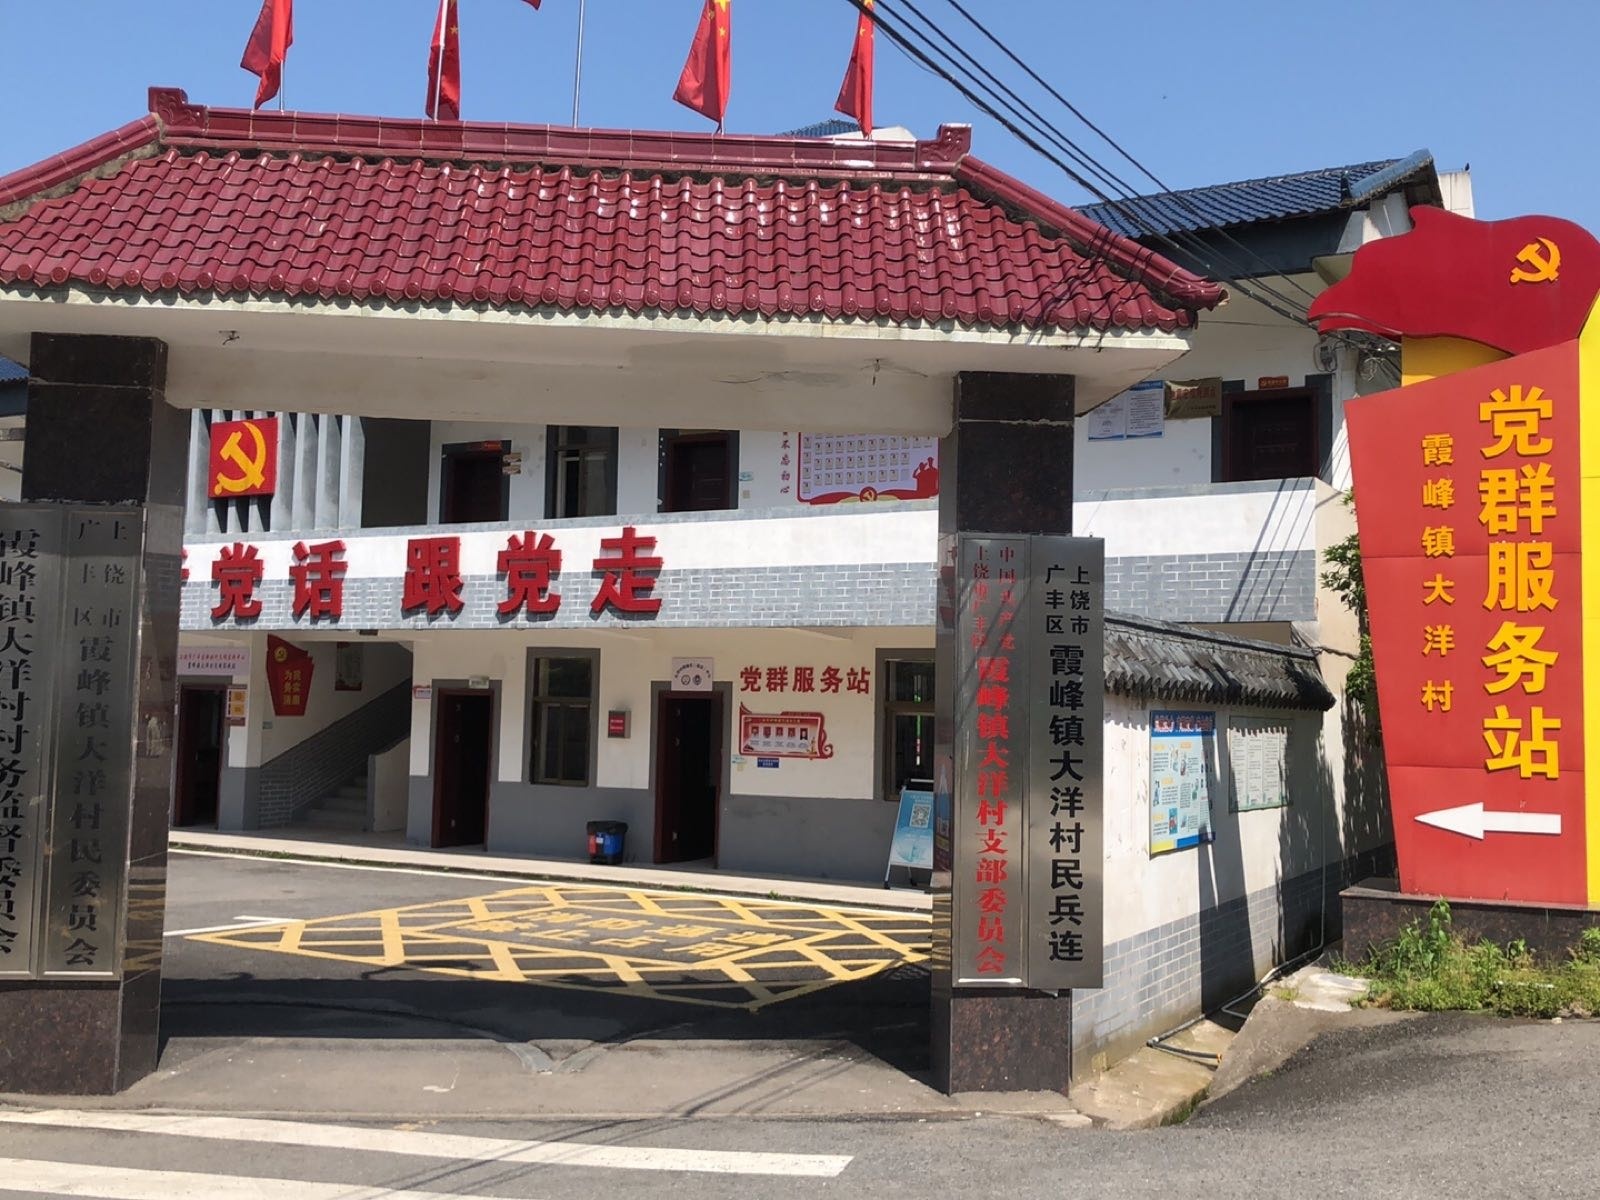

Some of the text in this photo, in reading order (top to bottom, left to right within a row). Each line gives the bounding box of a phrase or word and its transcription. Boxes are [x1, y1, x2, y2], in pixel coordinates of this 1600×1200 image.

[102, 520, 127, 628] 上饶市
[180, 526, 664, 619] 党话跟党走
[1045, 564, 1065, 635] 广丰区
[1070, 566, 1091, 636] 上饶市
[1421, 433, 1456, 714] 霞峰镇大洋村
[1479, 384, 1561, 779] 党群服务站
[739, 665, 872, 695] 党群服务站
[64, 635, 113, 965] 霞峰镇大洋村民委员会
[976, 657, 1010, 974] 霞峰镇大洋村支部委员会
[1049, 645, 1085, 961] 霞峰镇大洋村民兵连
